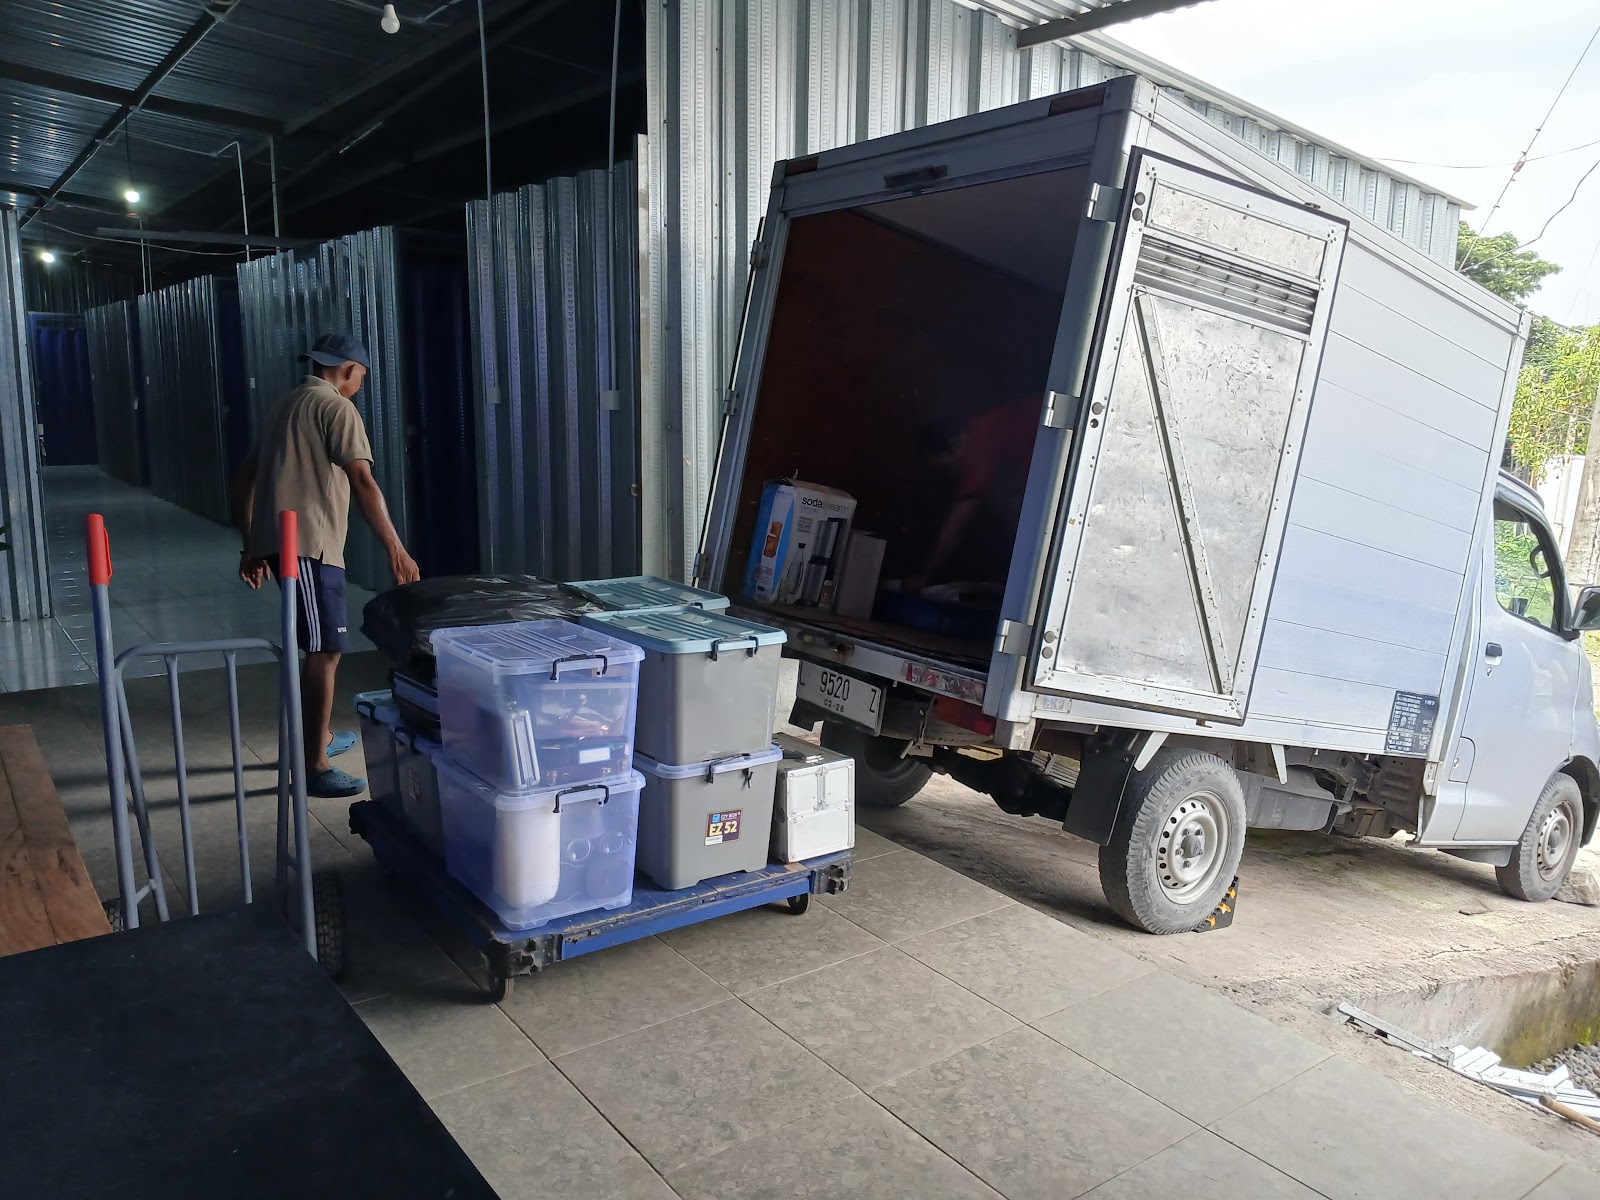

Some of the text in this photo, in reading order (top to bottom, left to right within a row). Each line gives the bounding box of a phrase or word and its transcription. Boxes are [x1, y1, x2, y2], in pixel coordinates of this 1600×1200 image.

[820, 671, 850, 701] 9520
[869, 688, 877, 713] Z
[824, 699, 844, 713] 02-28
[709, 820, 738, 836] EZ 52
